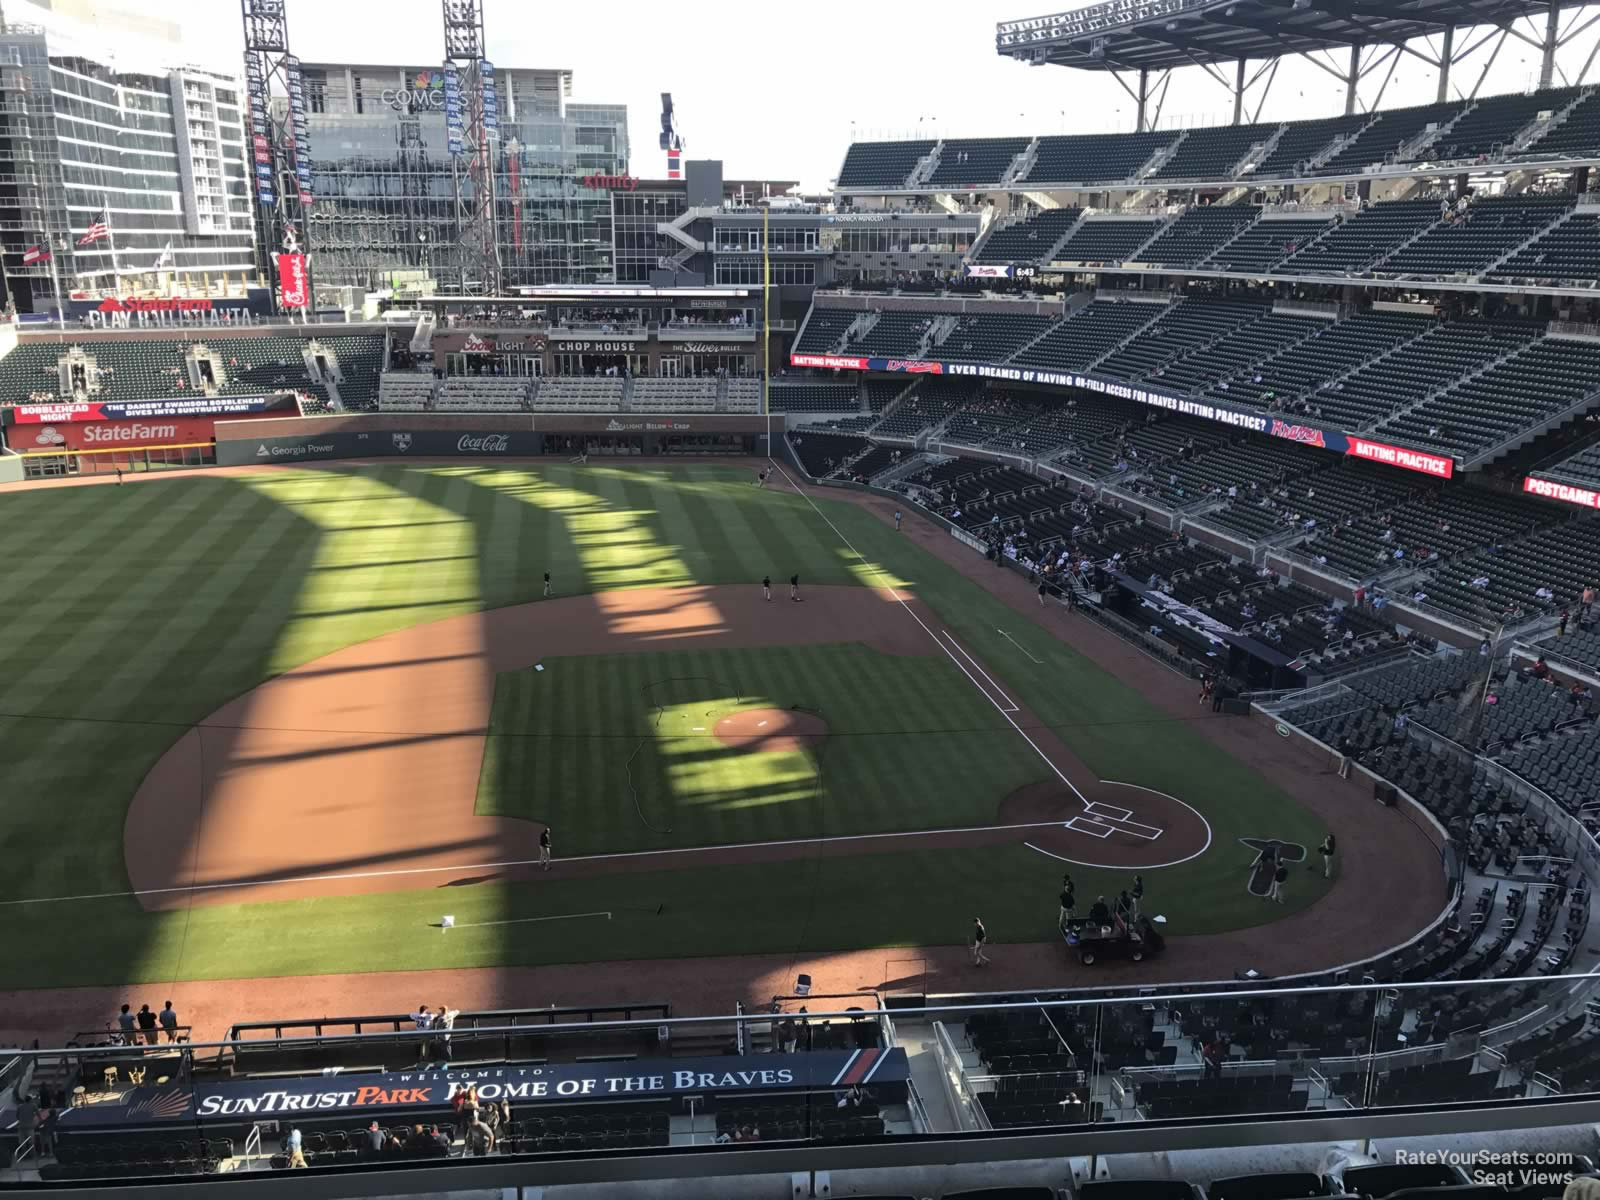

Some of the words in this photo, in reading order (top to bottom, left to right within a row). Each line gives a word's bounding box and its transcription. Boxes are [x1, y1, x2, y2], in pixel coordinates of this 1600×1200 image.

[381, 89, 478, 106] COMCST
[584, 172, 640, 192] xfinity
[1016, 268, 1035, 277] 6:43
[496, 342, 524, 351] LIGHT
[559, 342, 590, 351] CHOP
[596, 342, 635, 351] HOUSE
[683, 342, 720, 352] Silver
[794, 356, 825, 366] BATTING
[825, 358, 860, 368] PRACTICE
[948, 364, 976, 376] EVER
[978, 366, 1020, 380] DREAMED
[1023, 370, 1034, 381] OF
[1037, 371, 1072, 386] HAVING
[1075, 378, 1105, 393] ON-FIELD
[1106, 384, 1132, 397] ACCESS
[1132, 389, 1147, 402] FOR
[1148, 393, 1177, 409] BRAVES
[1178, 399, 1214, 418] BATTING
[1216, 408, 1266, 431] PRACTICE?
[21, 404, 88, 415] BOBBLEHEAD
[127, 402, 162, 410] DANSBY
[165, 400, 207, 408] SWANSON
[210, 398, 265, 406] BOBBLEHEAD
[177, 406, 222, 414] SUNTRUST
[40, 413, 72, 422] NIGHT
[271, 445, 306, 456] Georgia
[308, 443, 334, 453] Power
[1356, 442, 1396, 462] BATTING
[1396, 449, 1446, 474] PRACTICE
[1528, 478, 1596, 507] POSTGAME
[401, 1070, 503, 1082] WELCOME
[519, 1068, 543, 1076] TO
[444, 1081, 548, 1101] HOME
[557, 1079, 597, 1095] OF
[605, 1076, 664, 1092] THE
[672, 1069, 793, 1088] BRAVES
